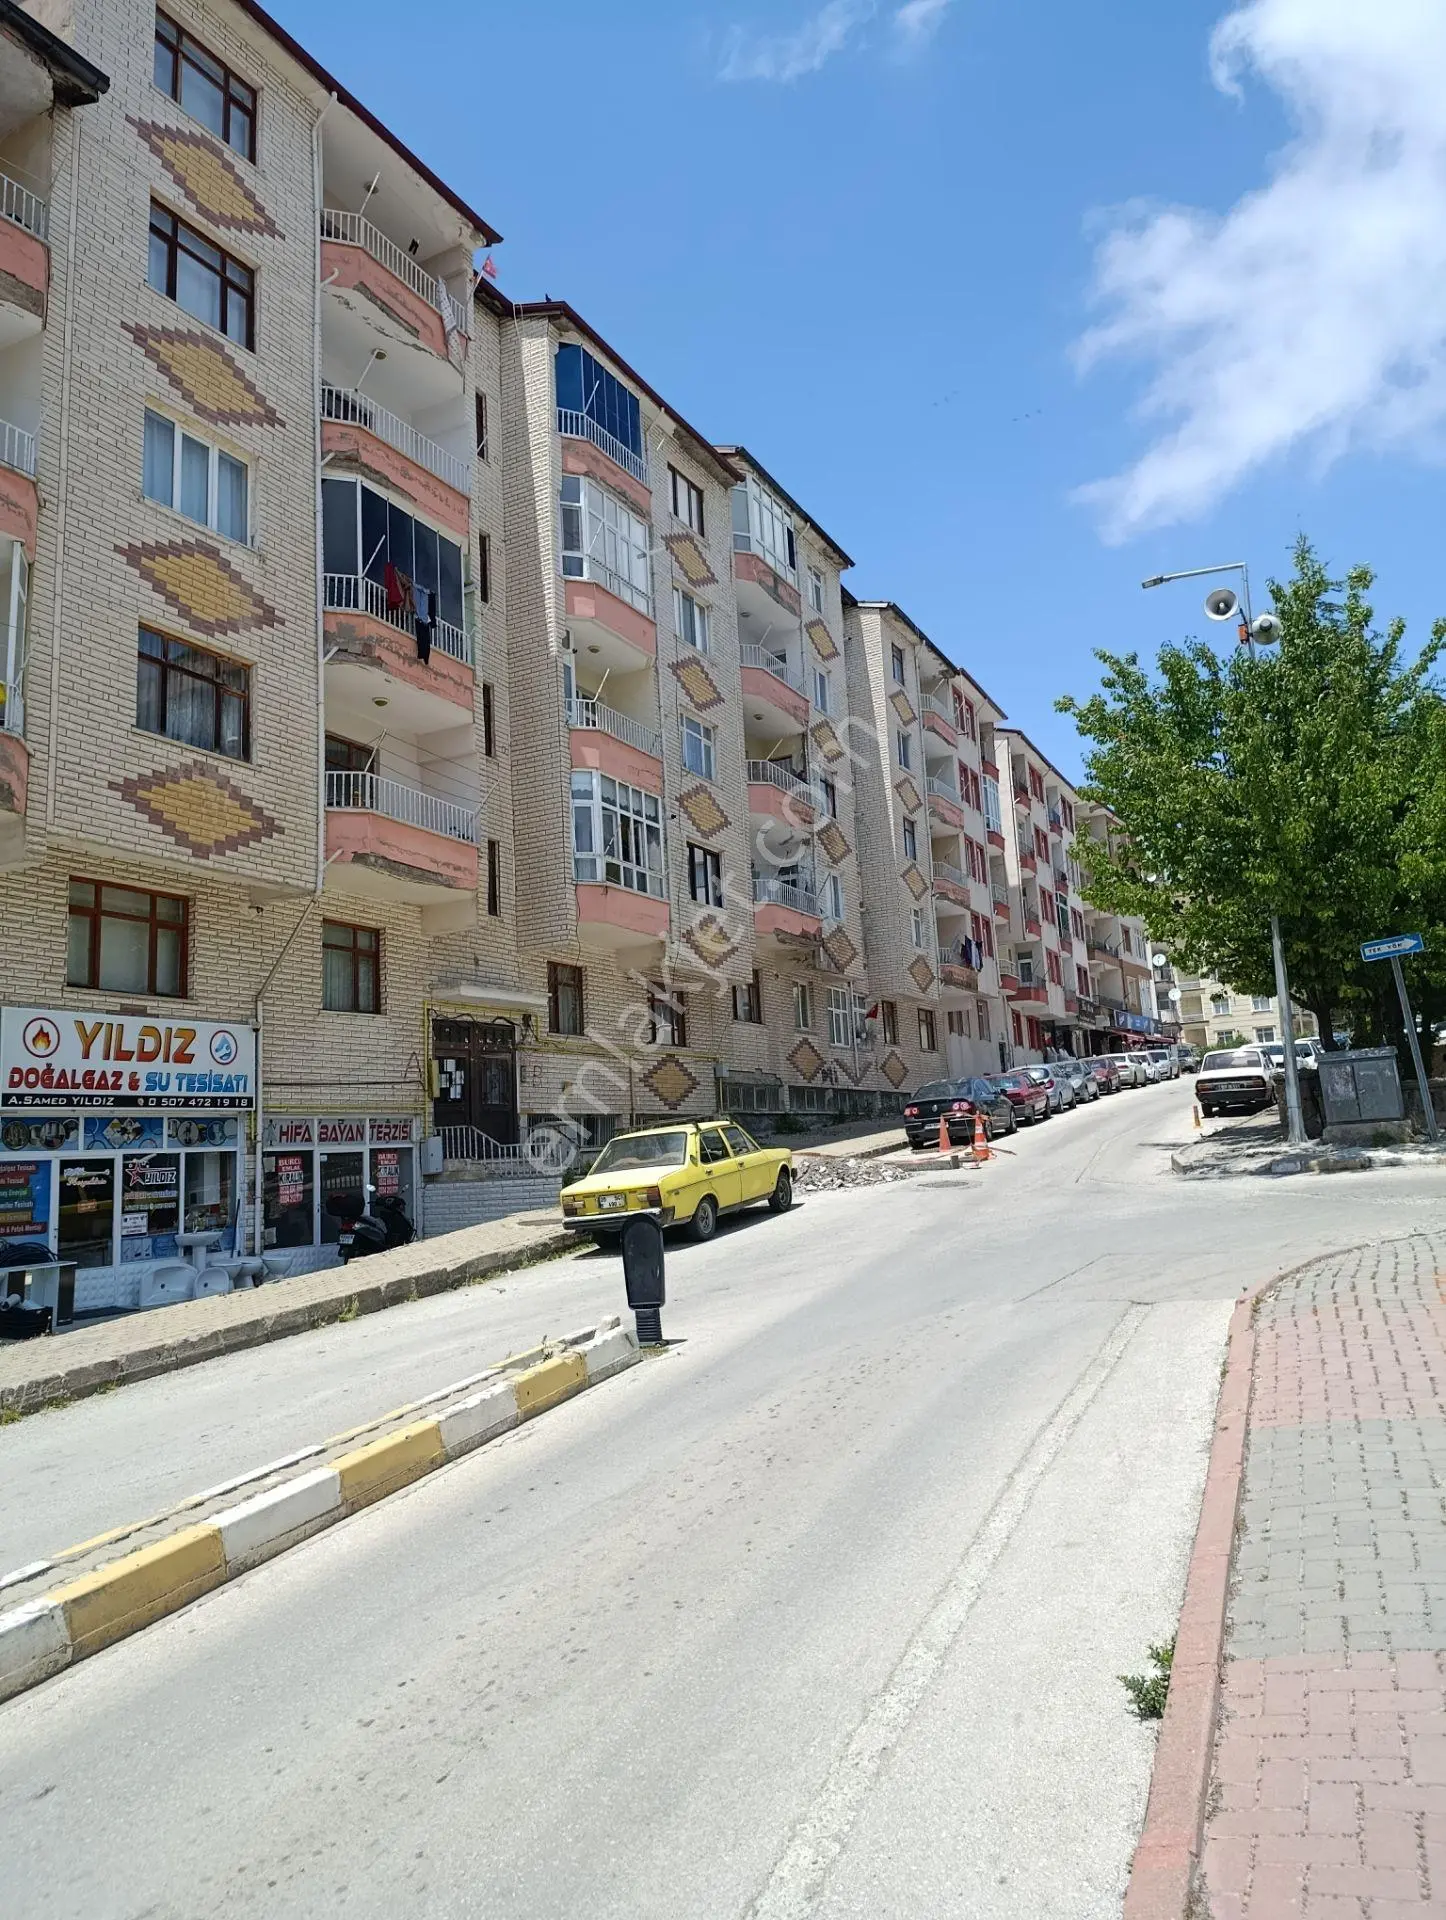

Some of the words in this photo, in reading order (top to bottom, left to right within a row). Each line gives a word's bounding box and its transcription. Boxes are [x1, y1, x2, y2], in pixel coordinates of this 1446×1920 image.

[74, 1020, 197, 1065] YILDIZ
[8, 1063, 123, 1091] DOĞALGAZ
[128, 1071, 140, 1091] &
[145, 1071, 171, 1092] SU
[175, 1068, 248, 1093] TESİSATI
[72, 1096, 115, 1106] YILDIZ
[148, 1098, 156, 1106] 0
[161, 1098, 184, 1107] 507
[189, 1099, 211, 1107] 472
[217, 1099, 229, 1107] 19
[235, 1099, 248, 1107] 18
[279, 1120, 313, 1143] HİFA
[319, 1123, 364, 1142] BAYAN
